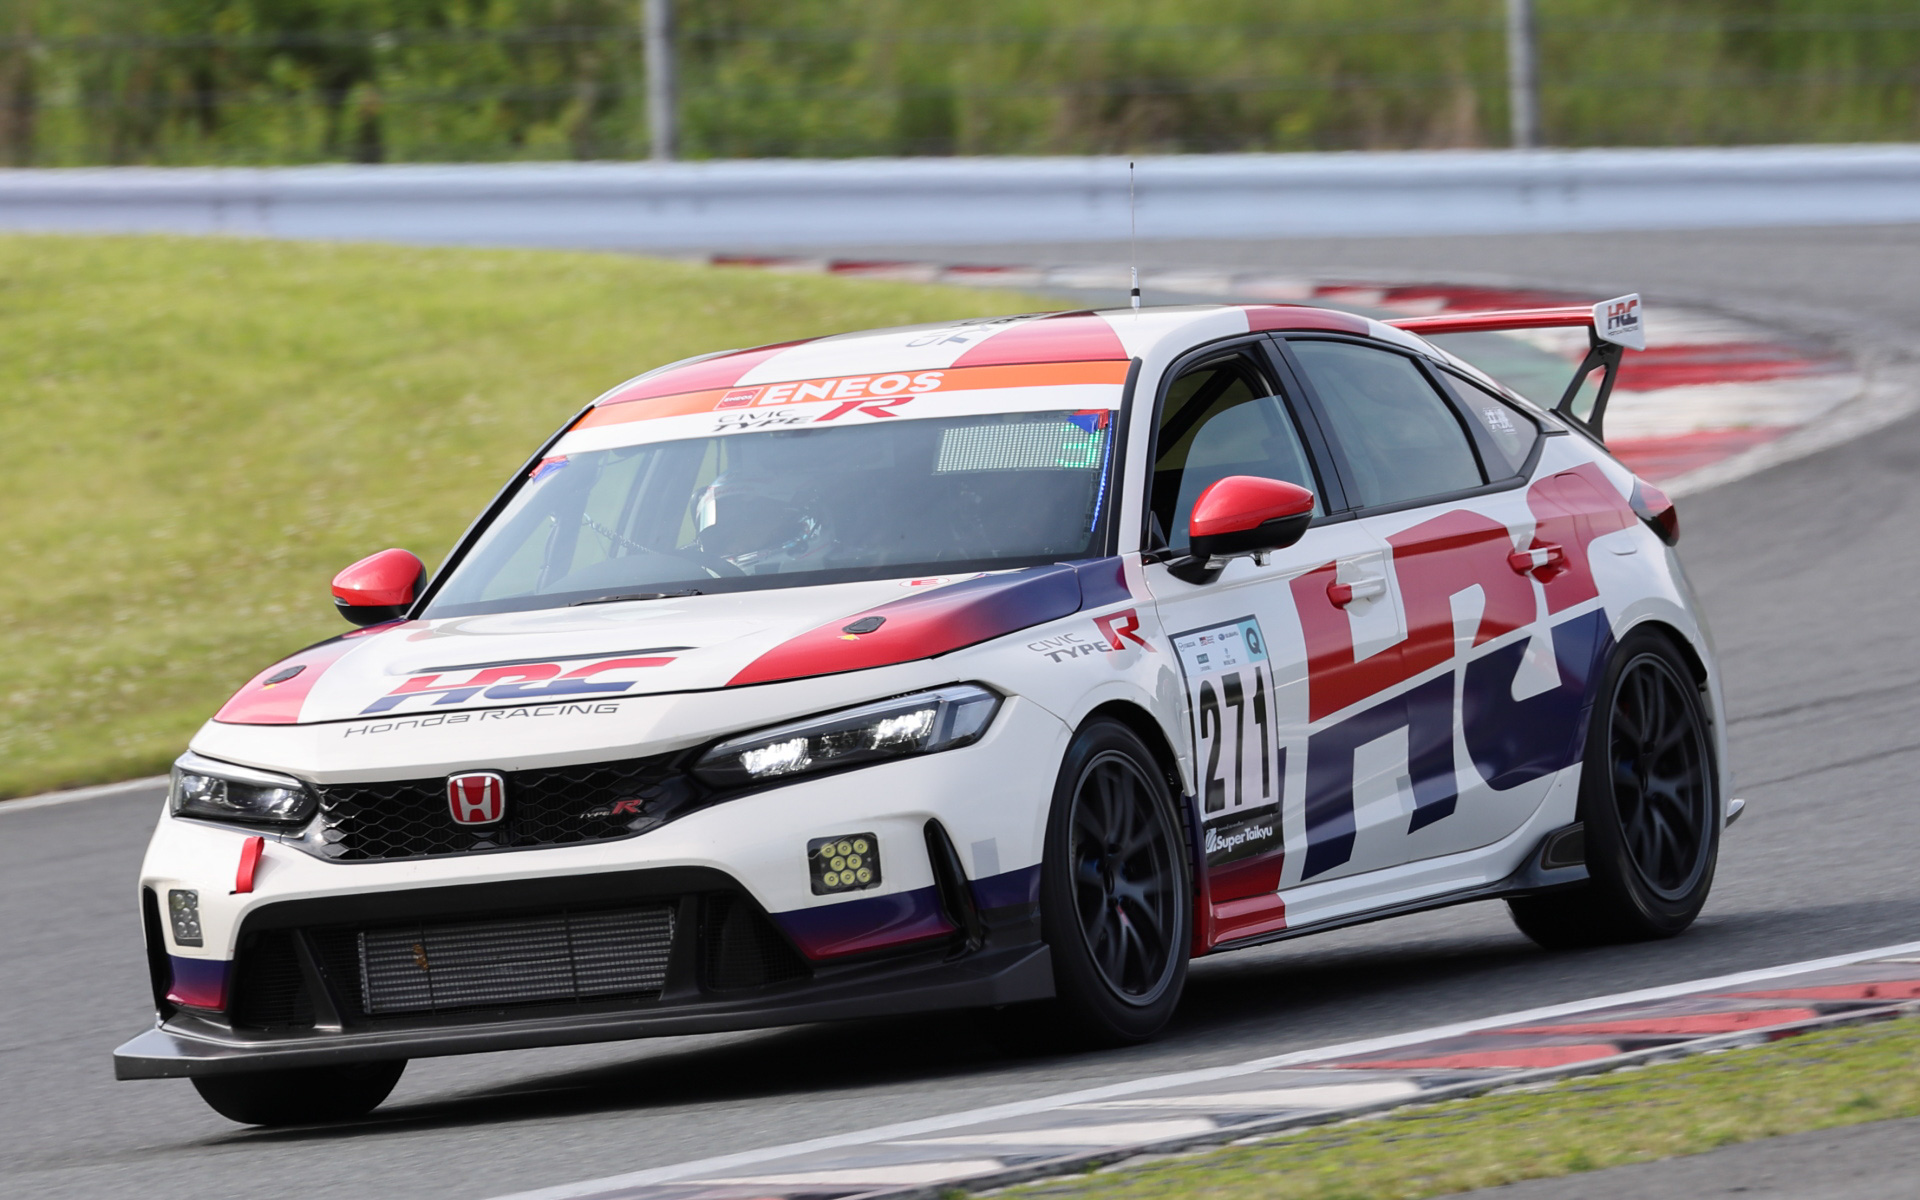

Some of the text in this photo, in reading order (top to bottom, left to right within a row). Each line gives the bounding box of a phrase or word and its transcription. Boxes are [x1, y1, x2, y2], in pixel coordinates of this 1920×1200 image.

[1608, 299, 1638, 330] HRC
[723, 393, 754, 403] ENEOS
[757, 371, 944, 406] ENEOS
[712, 396, 915, 432] TYPE R
[718, 408, 796, 424] CIVIC
[1027, 632, 1084, 652] CIVIC
[1044, 607, 1158, 663] TYPE R
[1246, 627, 1262, 655] Q
[358, 656, 678, 715] HRC
[1290, 462, 1638, 882] HRC
[343, 703, 620, 738] Honda RACING
[1199, 665, 1270, 815] 271
[611, 799, 643, 815] R
